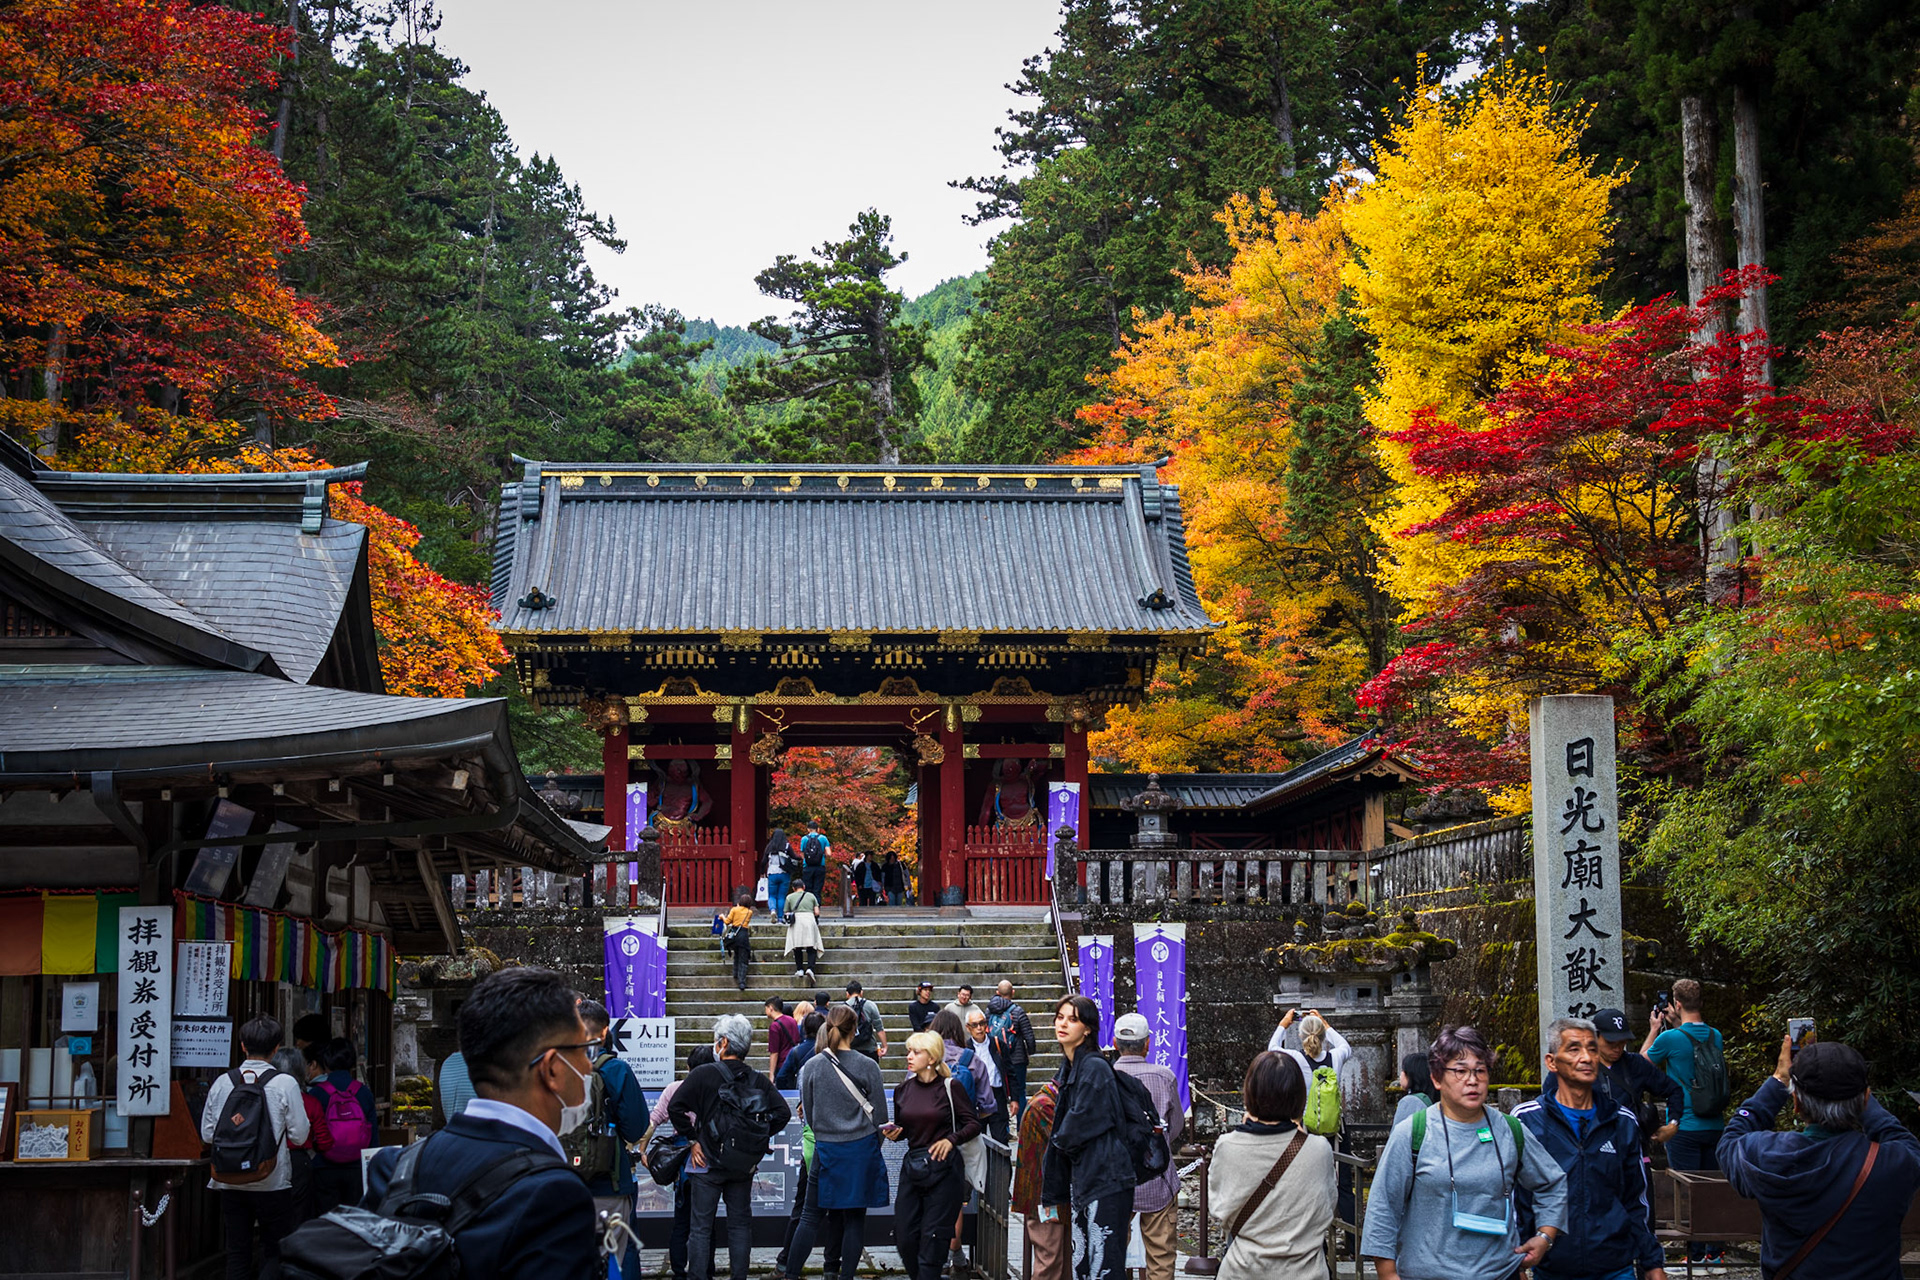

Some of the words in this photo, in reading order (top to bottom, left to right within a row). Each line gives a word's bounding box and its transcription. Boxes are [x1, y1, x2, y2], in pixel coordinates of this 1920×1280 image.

[211, 944, 227, 1013] 拝観券受付所
[127, 916, 162, 1105] 拝観券受付所
[637, 1023, 670, 1040] 入口
[75, 1120, 84, 1152] おみくじ
